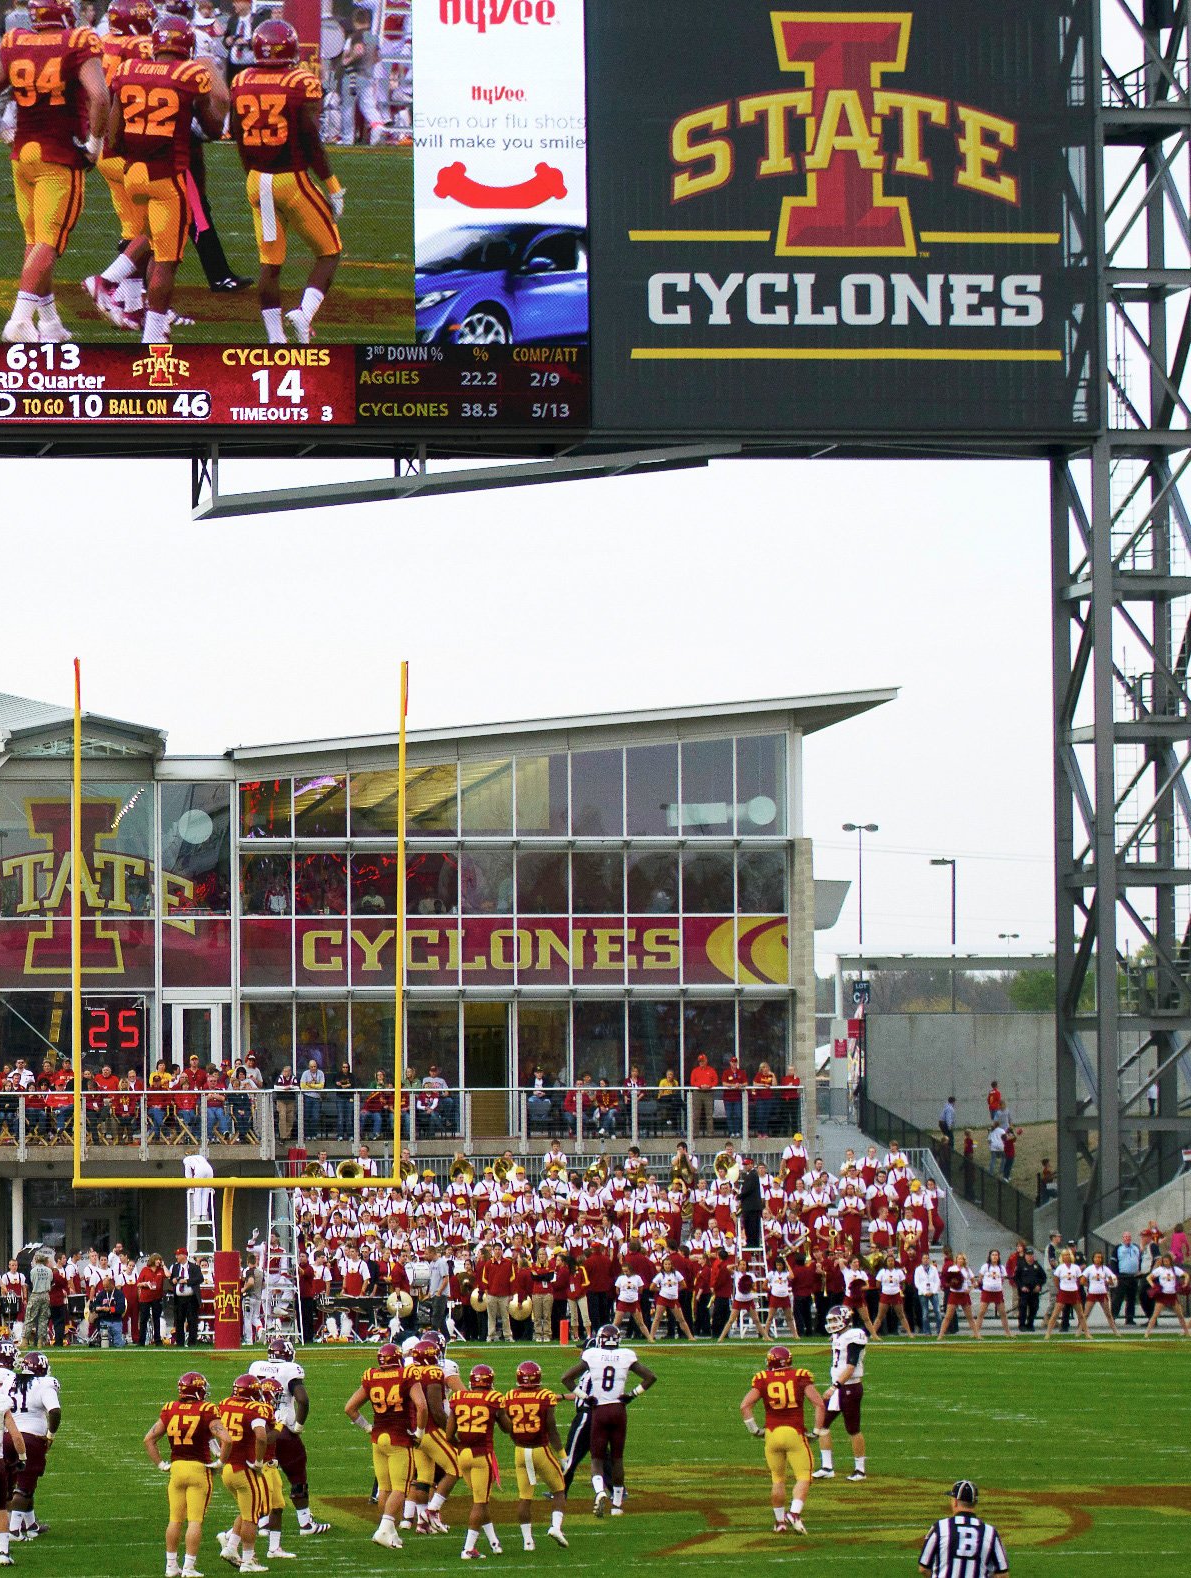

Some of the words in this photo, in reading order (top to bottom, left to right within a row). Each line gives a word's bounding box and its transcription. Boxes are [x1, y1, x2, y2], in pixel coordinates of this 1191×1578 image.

[10, 58, 66, 107] 94
[472, 86, 525, 104] HyVee
[120, 85, 180, 137] 22
[236, 94, 288, 146] 23
[413, 113, 459, 129] Even
[467, 117, 498, 129] our
[506, 114, 528, 129] flu
[535, 114, 585, 129] shots
[413, 135, 443, 148] will
[450, 135, 495, 148] make
[503, 138, 533, 151] you
[540, 136, 585, 149] smile
[671, 89, 1018, 203] STATE
[647, 272, 1044, 327] CYCLONES
[6, 344, 80, 370] 6:13
[132, 358, 189, 377] STATE
[222, 349, 330, 366] CYCLONES
[388, 347, 427, 360] DOWN
[430, 347, 443, 361] %
[473, 348, 489, 361] %
[513, 348, 578, 362] COMP/ATT
[28, 373, 105, 391] Quarter
[251, 369, 305, 404] 14
[359, 371, 420, 385] AGGIES
[461, 372, 497, 386] 22.2
[530, 372, 560, 387] 2/9
[23, 399, 42, 415] TO
[44, 399, 64, 415] GO
[69, 395, 102, 417] 10
[109, 399, 143, 415] BALL
[147, 399, 167, 415] ON
[173, 394, 209, 417] 46
[230, 407, 308, 421] TIMEOUTS
[321, 406, 333, 421] 3
[359, 403, 449, 417] CYCLONES
[461, 403, 498, 417] 38.5
[532, 403, 570, 418] 5/13
[302, 928, 681, 971] CYCLONES
[88, 1009, 140, 1048] 25
[602, 1366, 615, 1391] 8
[370, 1384, 403, 1413] 94
[767, 1380, 798, 1409] 91
[167, 1415, 200, 1445] 47
[220, 1411, 243, 1441] 45
[455, 1405, 489, 1433] 22
[509, 1404, 540, 1433] 23
[956, 1526, 978, 1557] B
